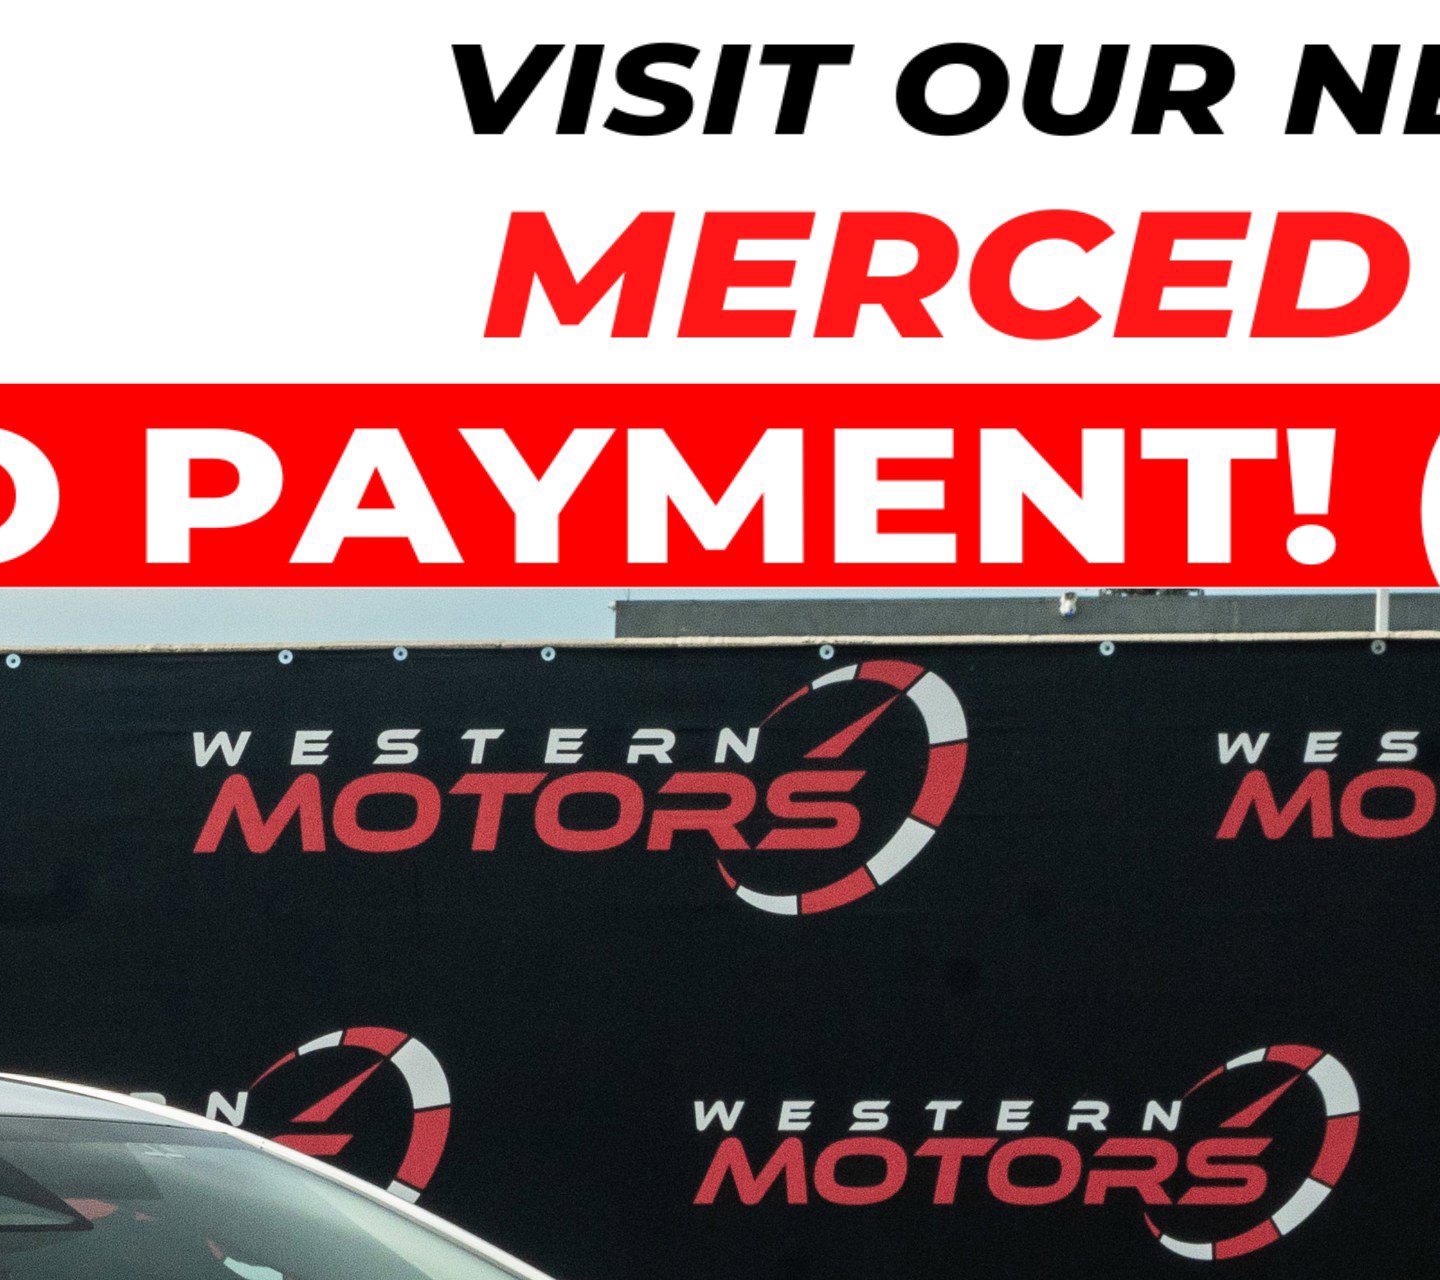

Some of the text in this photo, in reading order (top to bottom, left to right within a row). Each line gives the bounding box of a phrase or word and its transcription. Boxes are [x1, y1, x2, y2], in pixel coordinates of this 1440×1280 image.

[193, 728, 759, 767] WESTERN
[192, 769, 867, 854] MOTORS
[694, 1100, 1181, 1131] WESTERN
[692, 1136, 1273, 1205] MOTORS
